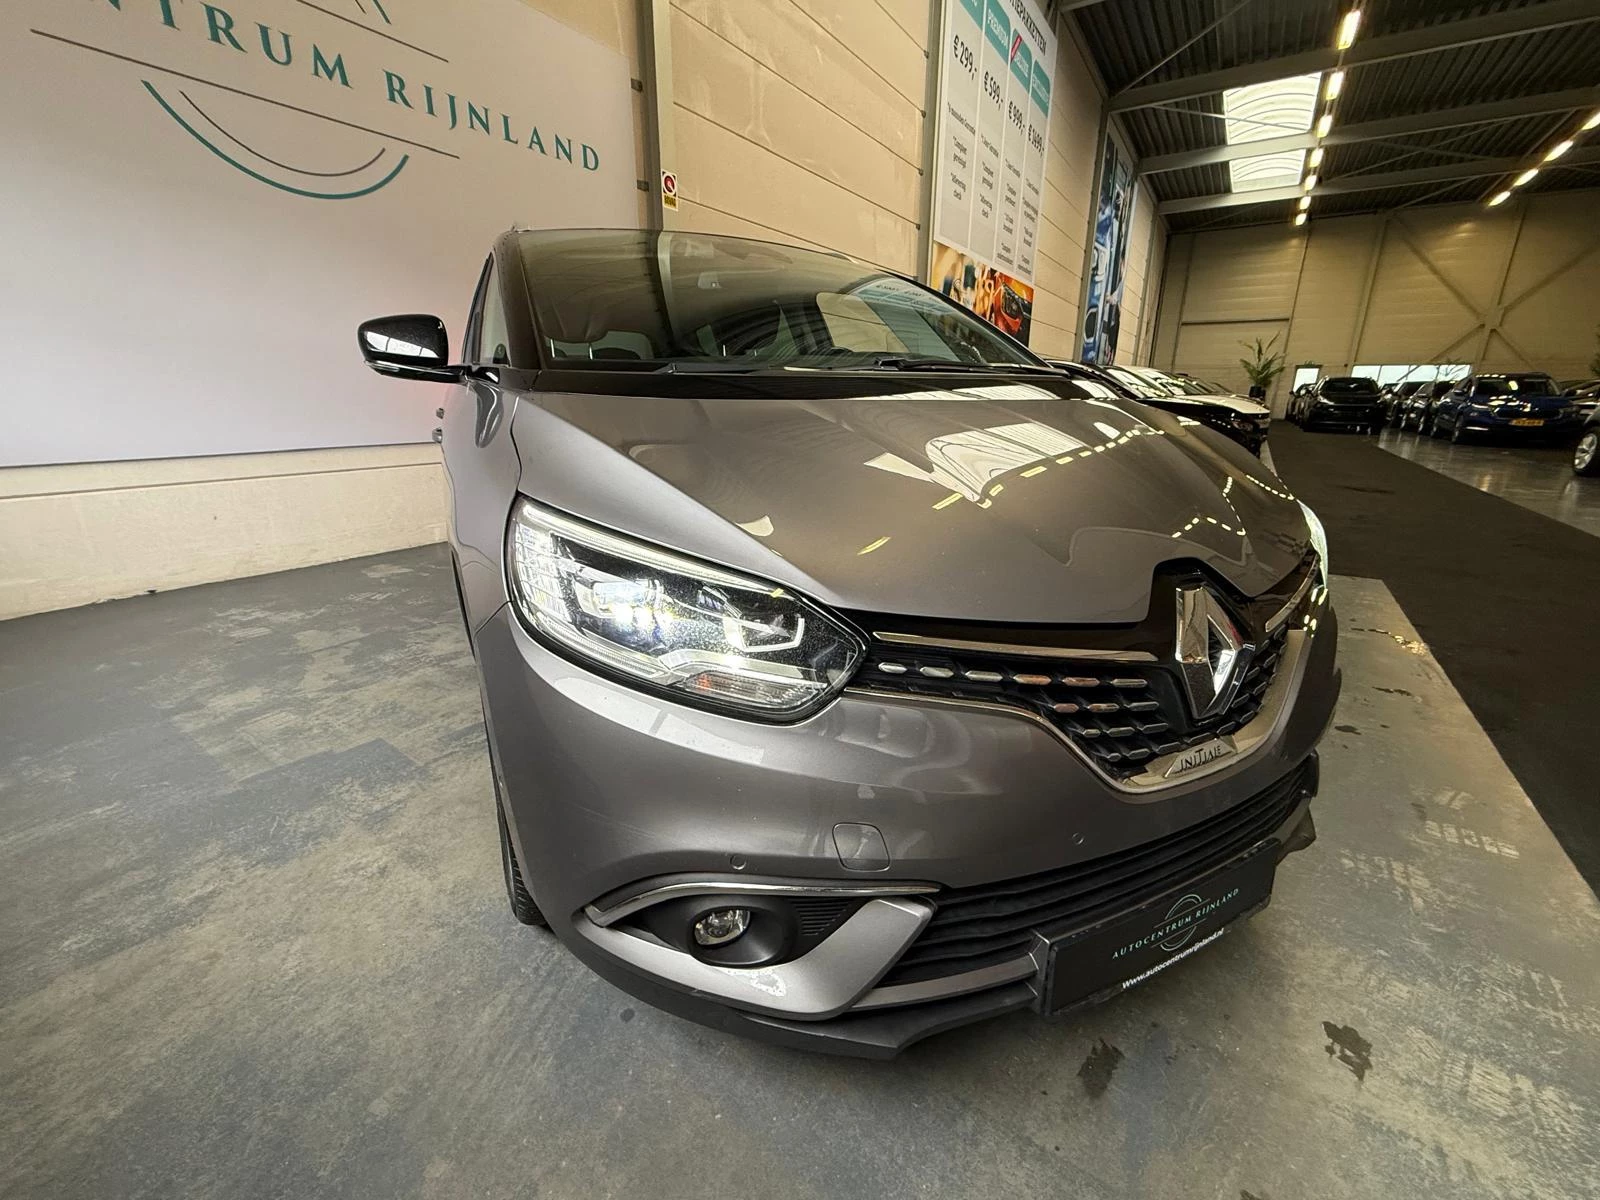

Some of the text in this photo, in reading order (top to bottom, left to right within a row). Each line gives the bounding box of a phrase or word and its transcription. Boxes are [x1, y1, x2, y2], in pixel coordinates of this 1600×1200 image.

[107, 0, 599, 171] TRUM RIJNLAND
[1112, 888, 1239, 959] AUTOCENTRUM RIJNLAND
